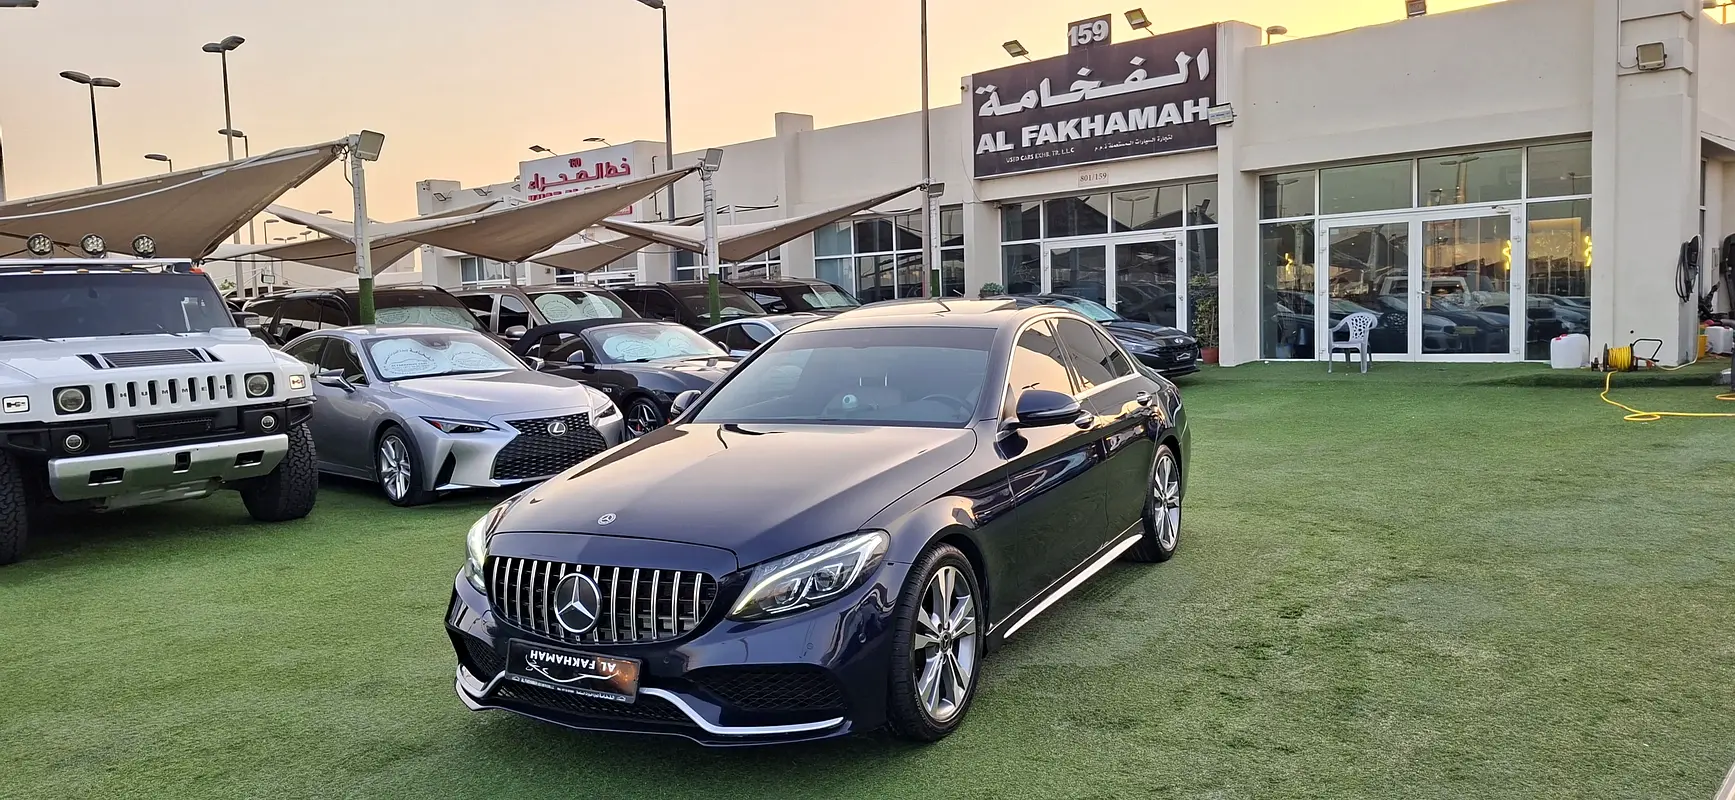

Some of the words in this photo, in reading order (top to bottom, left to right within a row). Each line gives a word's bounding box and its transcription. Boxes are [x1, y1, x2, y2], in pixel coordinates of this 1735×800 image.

[1067, 19, 1109, 47] 159
[975, 48, 1210, 117] الفخامة
[976, 131, 1014, 155] AL
[1021, 97, 1210, 148] FAKHAMAH
[605, 157, 631, 178] خط
[1020, 153, 1034, 161] CARS
[528, 163, 604, 192] الصحراء
[1080, 172, 1107, 182] 801/159
[530, 649, 596, 670] FAKHAMAH
[601, 661, 617, 673] AL
